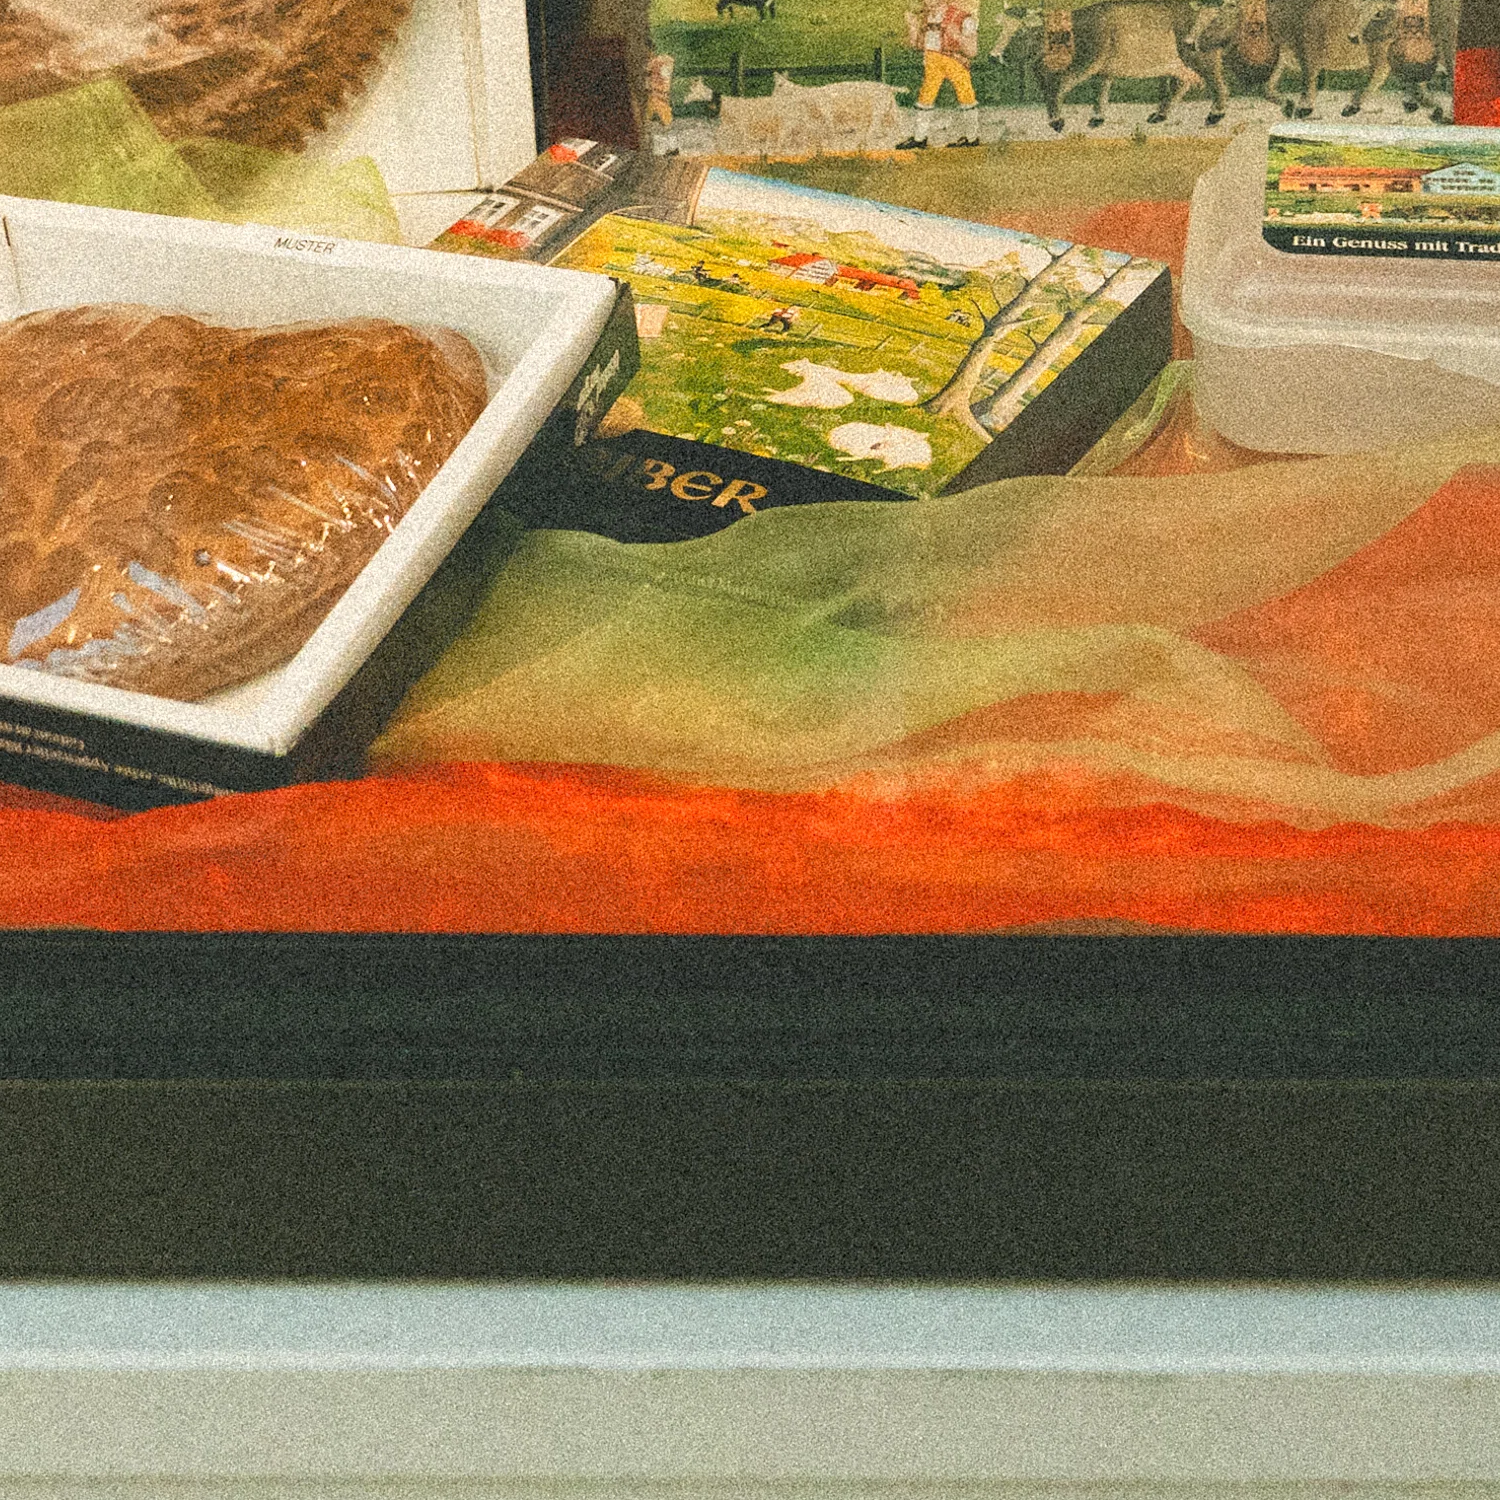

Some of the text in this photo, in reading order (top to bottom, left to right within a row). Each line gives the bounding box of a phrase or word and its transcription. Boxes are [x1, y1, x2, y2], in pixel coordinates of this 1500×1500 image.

[274, 236, 337, 255] MUSTER
[1291, 234, 1326, 248] Ein
[1332, 236, 1408, 251] Genuss
[1414, 238, 1449, 253] mit
